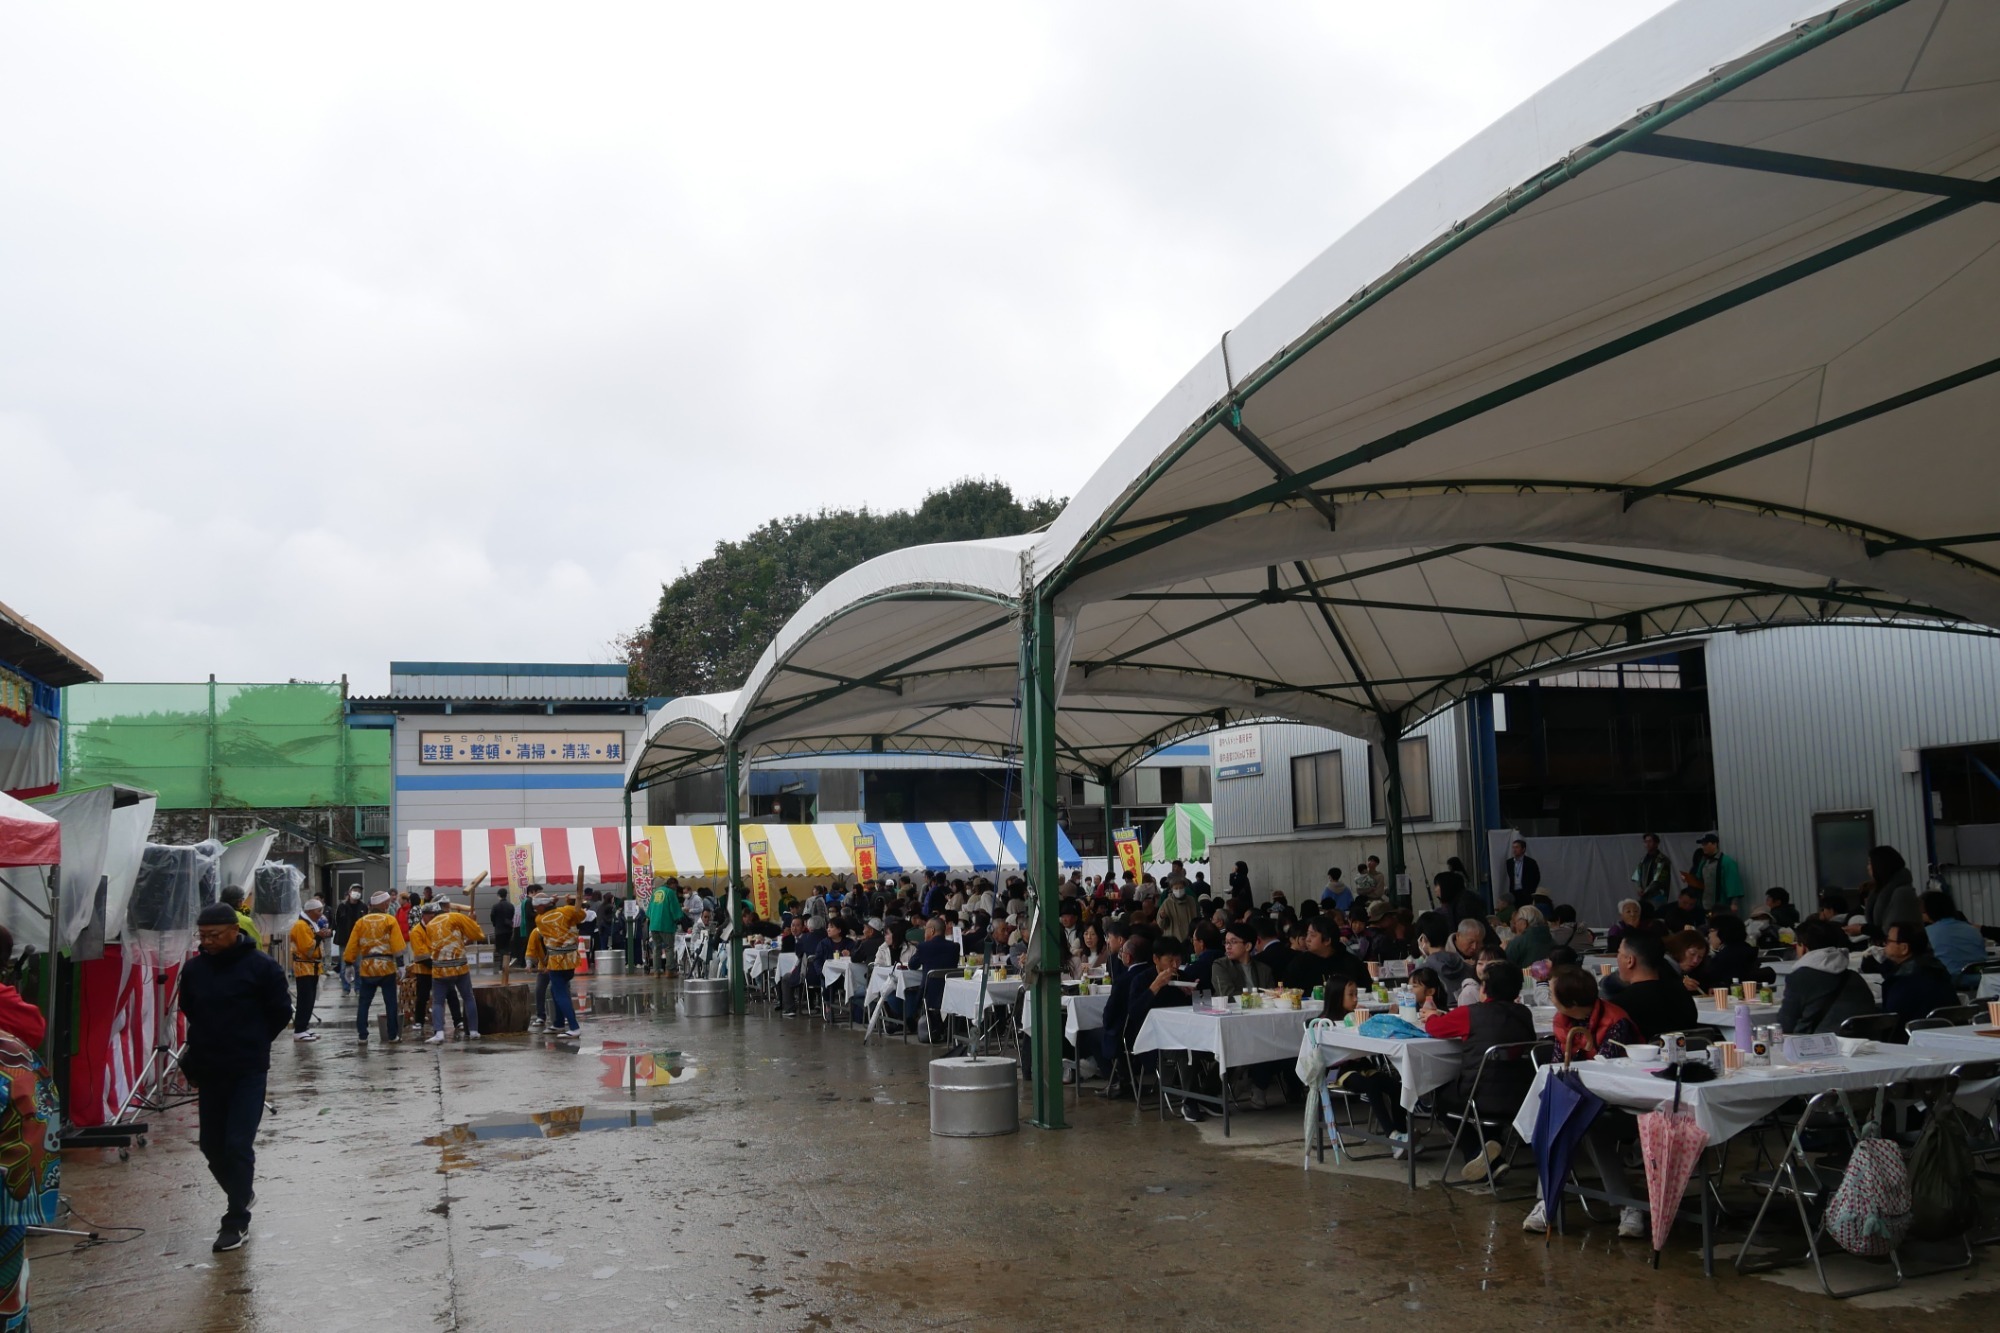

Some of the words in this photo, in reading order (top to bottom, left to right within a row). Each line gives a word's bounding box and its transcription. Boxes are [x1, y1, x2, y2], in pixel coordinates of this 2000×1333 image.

[423, 743, 621, 761] 整理・整頓・清掃・清潔・躾
